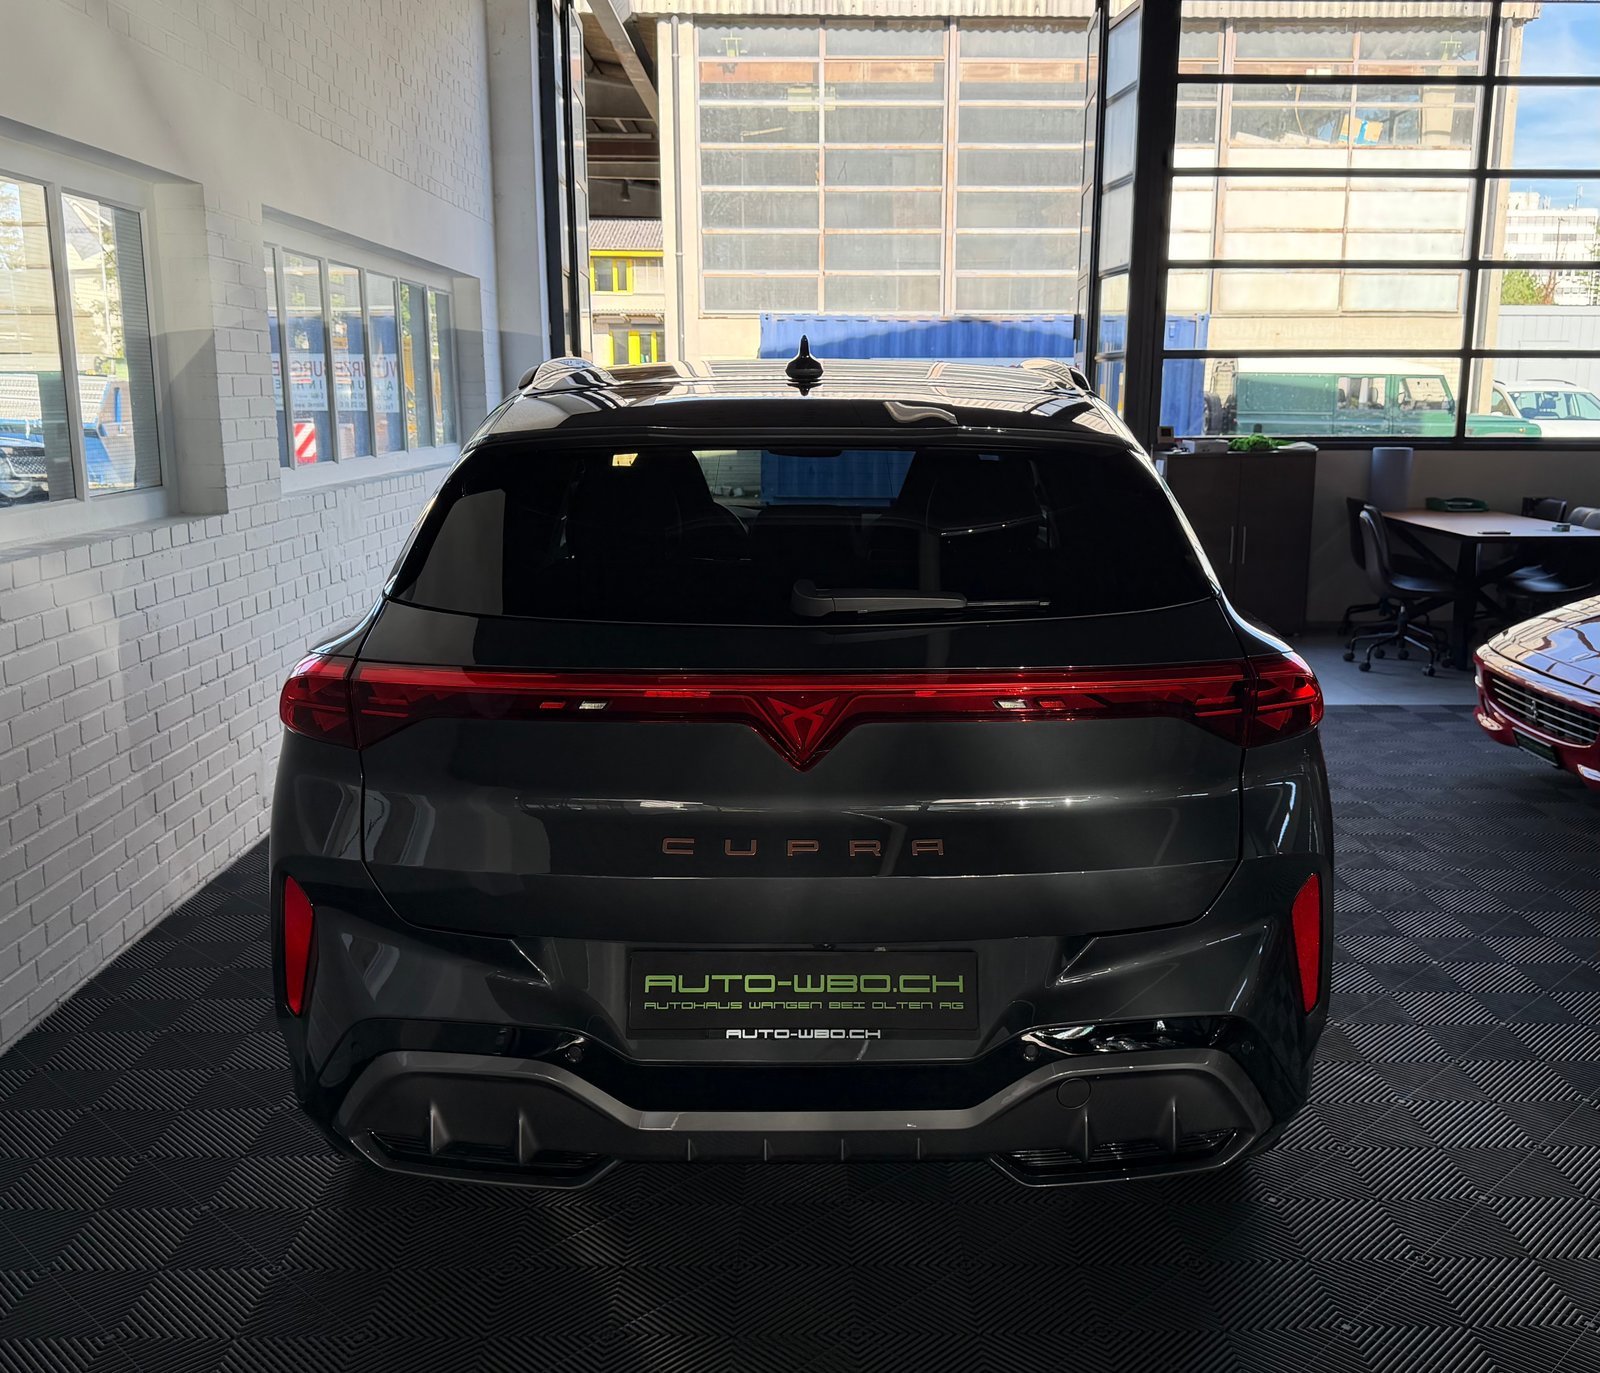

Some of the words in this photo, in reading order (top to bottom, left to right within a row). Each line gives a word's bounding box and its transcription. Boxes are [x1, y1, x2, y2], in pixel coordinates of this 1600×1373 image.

[662, 838, 944, 857] CUPRA
[644, 975, 964, 993] AUTO-WBO.CH
[644, 1001, 743, 1010] AUTOHAUS
[748, 1001, 822, 1010] WANGEN
[828, 1001, 865, 1010] BEI
[872, 1001, 933, 1010] OLTEN
[939, 1001, 964, 1010] AG
[725, 1029, 881, 1039] AUTO-WBO.CH
